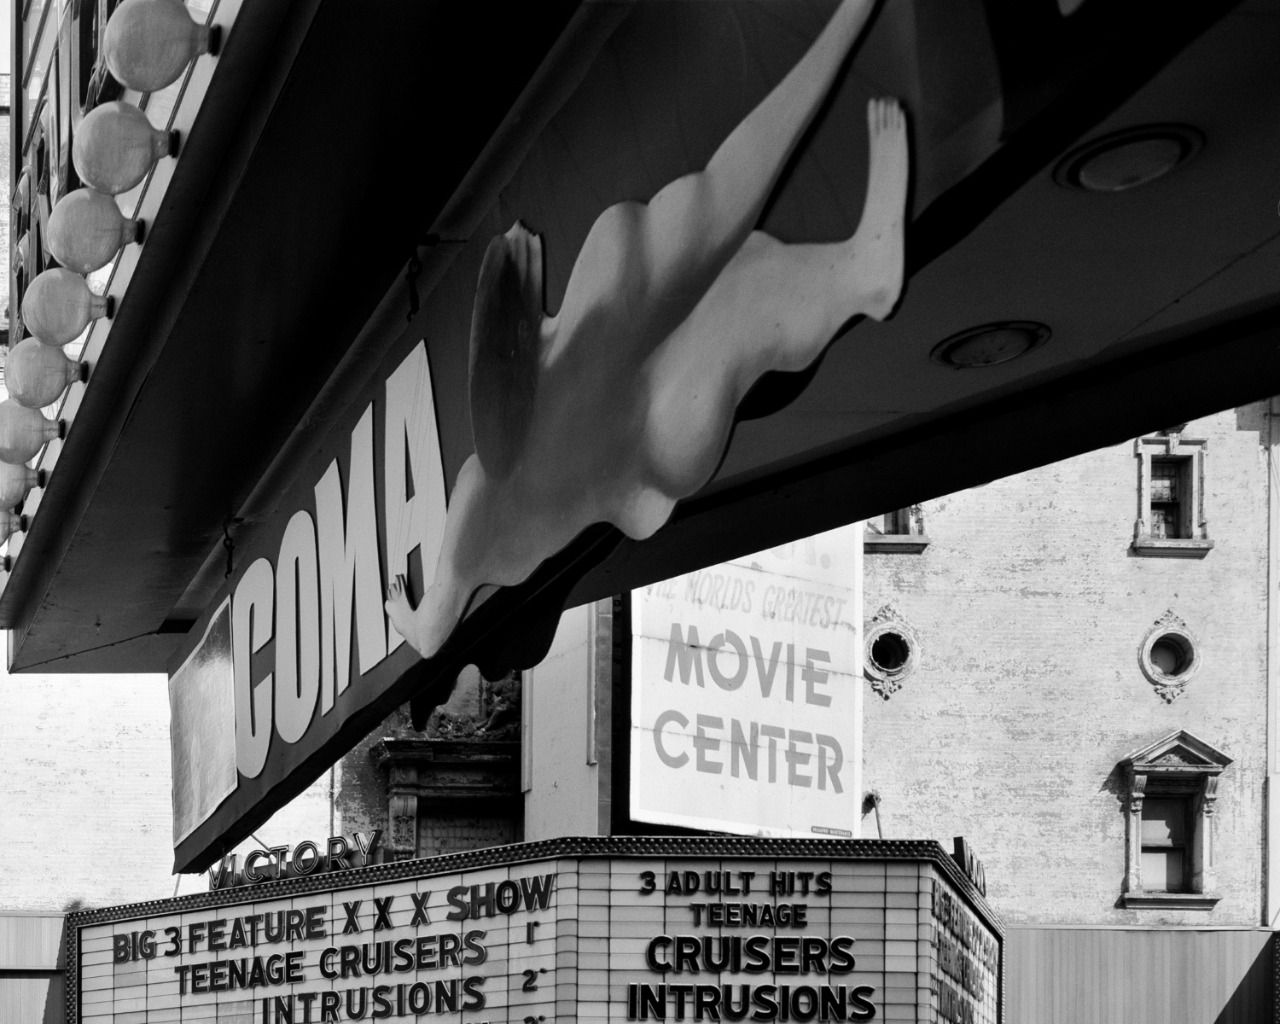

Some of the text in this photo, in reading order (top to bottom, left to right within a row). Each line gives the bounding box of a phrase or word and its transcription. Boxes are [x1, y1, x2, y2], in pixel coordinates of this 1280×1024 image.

[232, 338, 449, 779] COMA
[664, 623, 833, 708] MOVIE
[652, 709, 844, 794] CENTER
[209, 830, 382, 889] VICTORY
[639, 870, 833, 897] 3 ADULT HITS
[113, 873, 556, 964] BIG 3 FEATURE X X X SHOW
[690, 902, 808, 929] TEENAGE
[175, 949, 305, 996] TEENAGE
[319, 928, 489, 980] CRUISERS
[645, 934, 857, 975] CRUISERS
[628, 982, 877, 1023] INTRUSIONS
